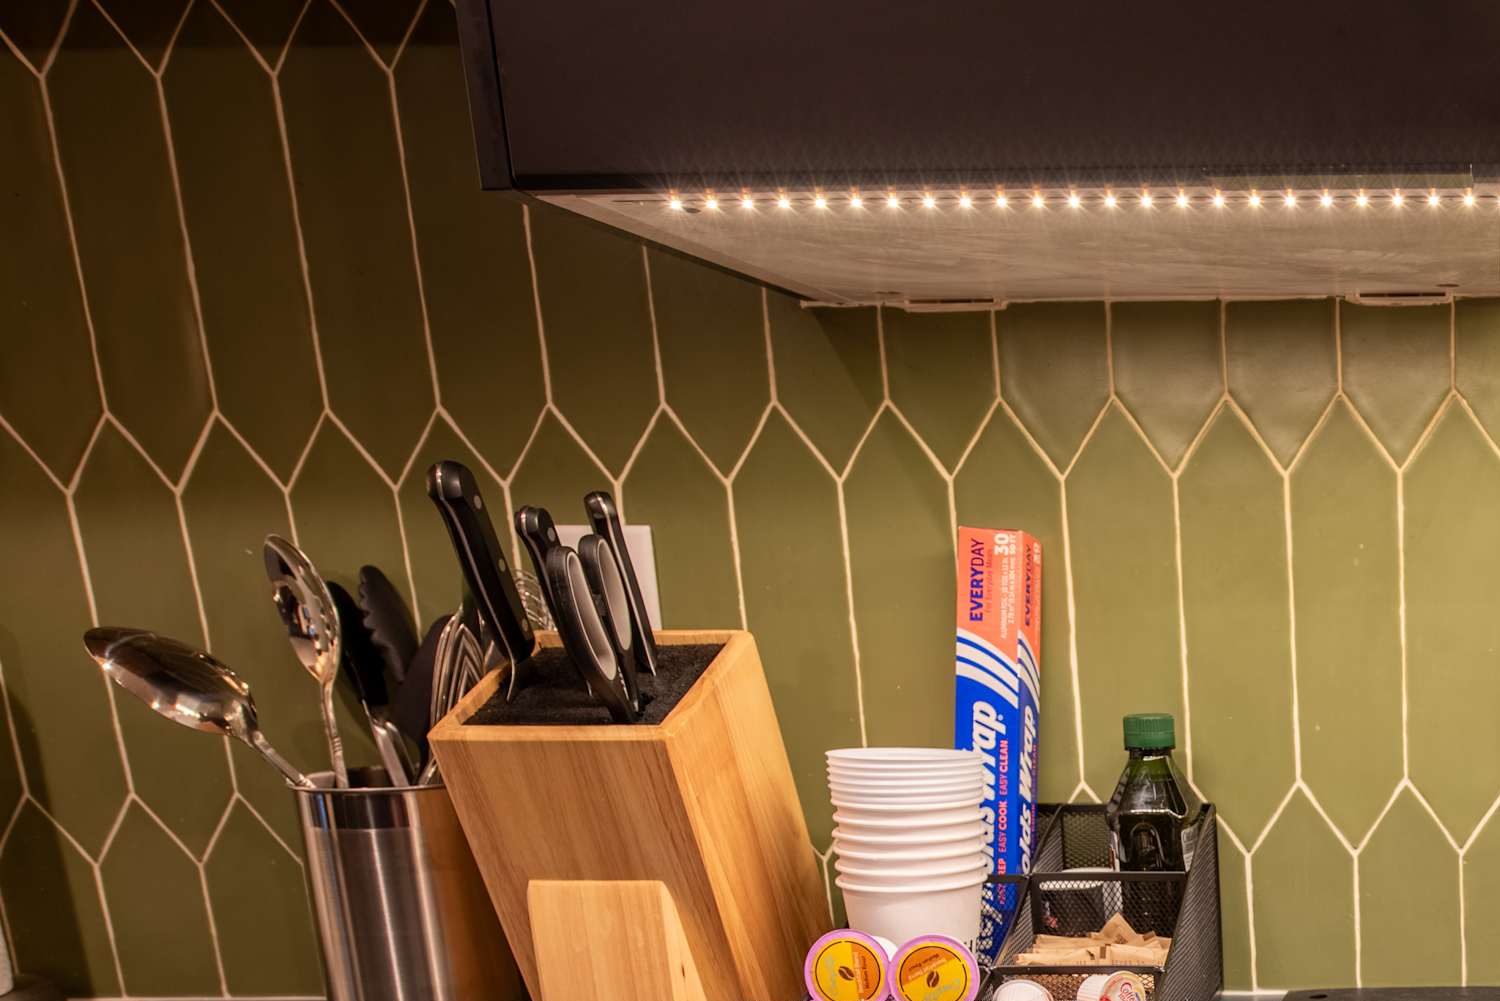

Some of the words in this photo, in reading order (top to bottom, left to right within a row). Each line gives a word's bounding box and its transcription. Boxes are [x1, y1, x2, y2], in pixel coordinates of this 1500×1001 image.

[994, 533, 1009, 556] 30
[969, 538, 984, 622] EVERYDAY
[1025, 544, 1033, 626] EVERYDAY
[999, 739, 1009, 773] CLEAN
[1019, 705, 1037, 803] Wrap
[999, 774, 1009, 796] EASY
[998, 801, 1008, 831] COOK
[998, 832, 1008, 853] EASY
